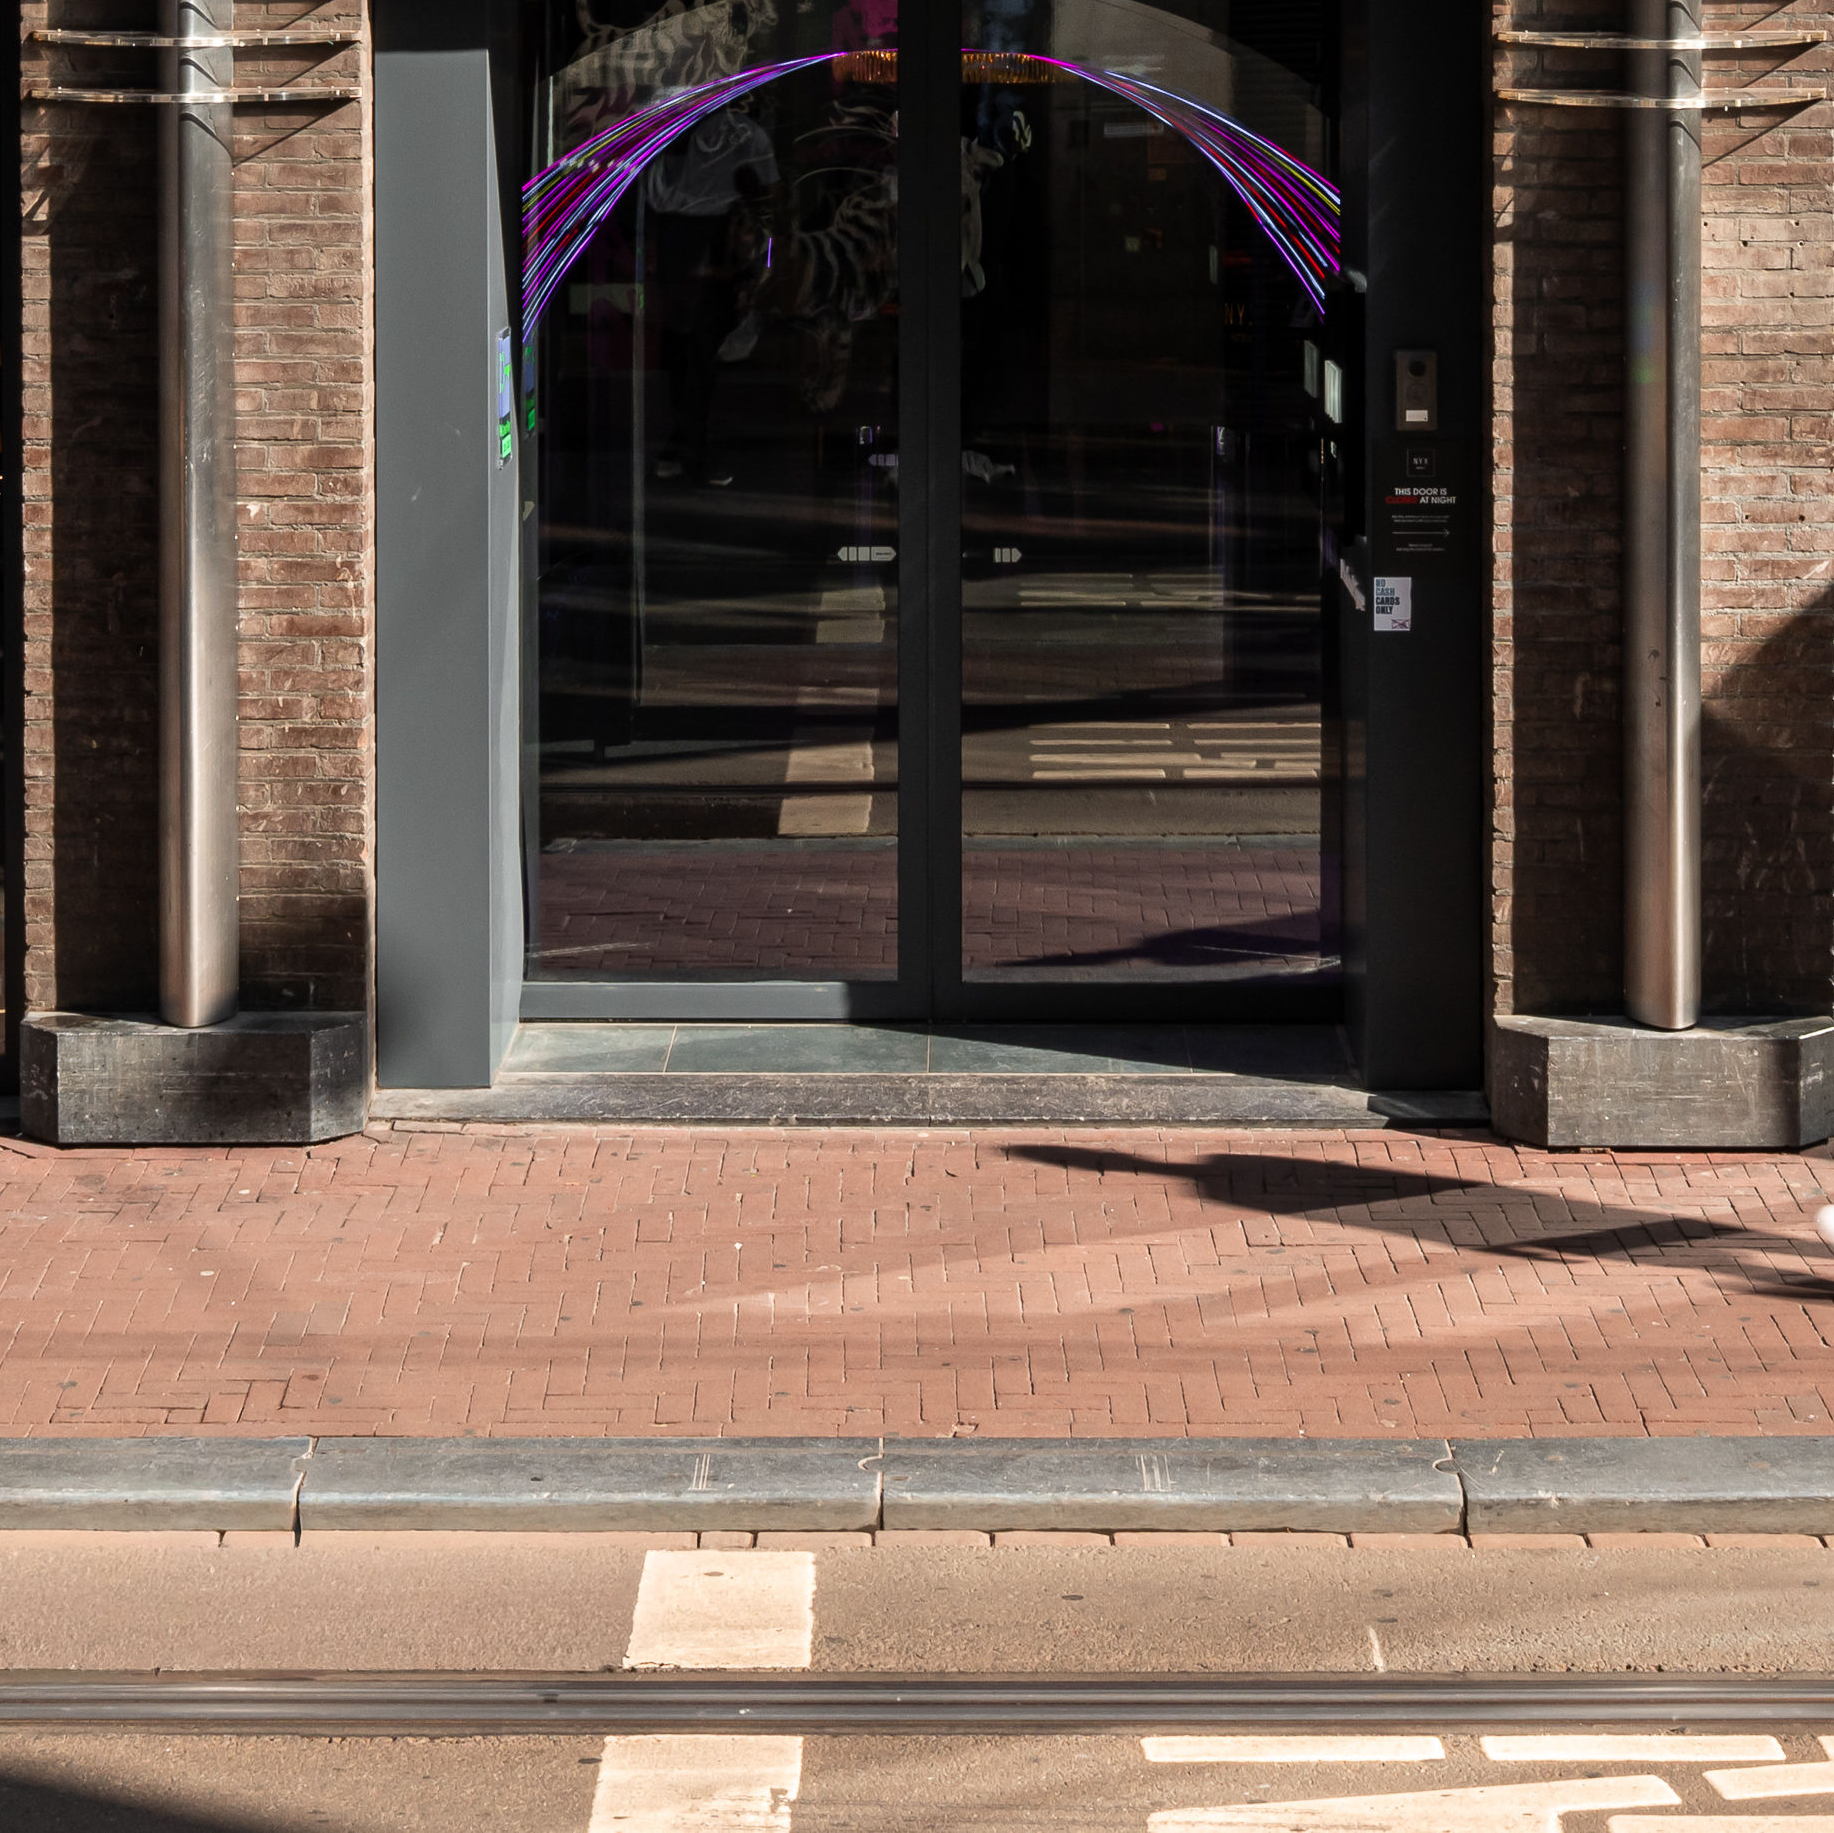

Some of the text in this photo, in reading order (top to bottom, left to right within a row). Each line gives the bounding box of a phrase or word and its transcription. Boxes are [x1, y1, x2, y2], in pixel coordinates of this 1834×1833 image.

[1224, 302, 1254, 327] NY
[1412, 457, 1429, 465] NYX
[1394, 487, 1448, 496] THIS DOOR IS
[1419, 495, 1429, 504] AT
[1430, 495, 1456, 504] NIGHT
[1375, 579, 1386, 588] NO
[1375, 587, 1395, 596] CASH
[1375, 596, 1400, 606] CARDS
[1375, 605, 1394, 615] ONLY
